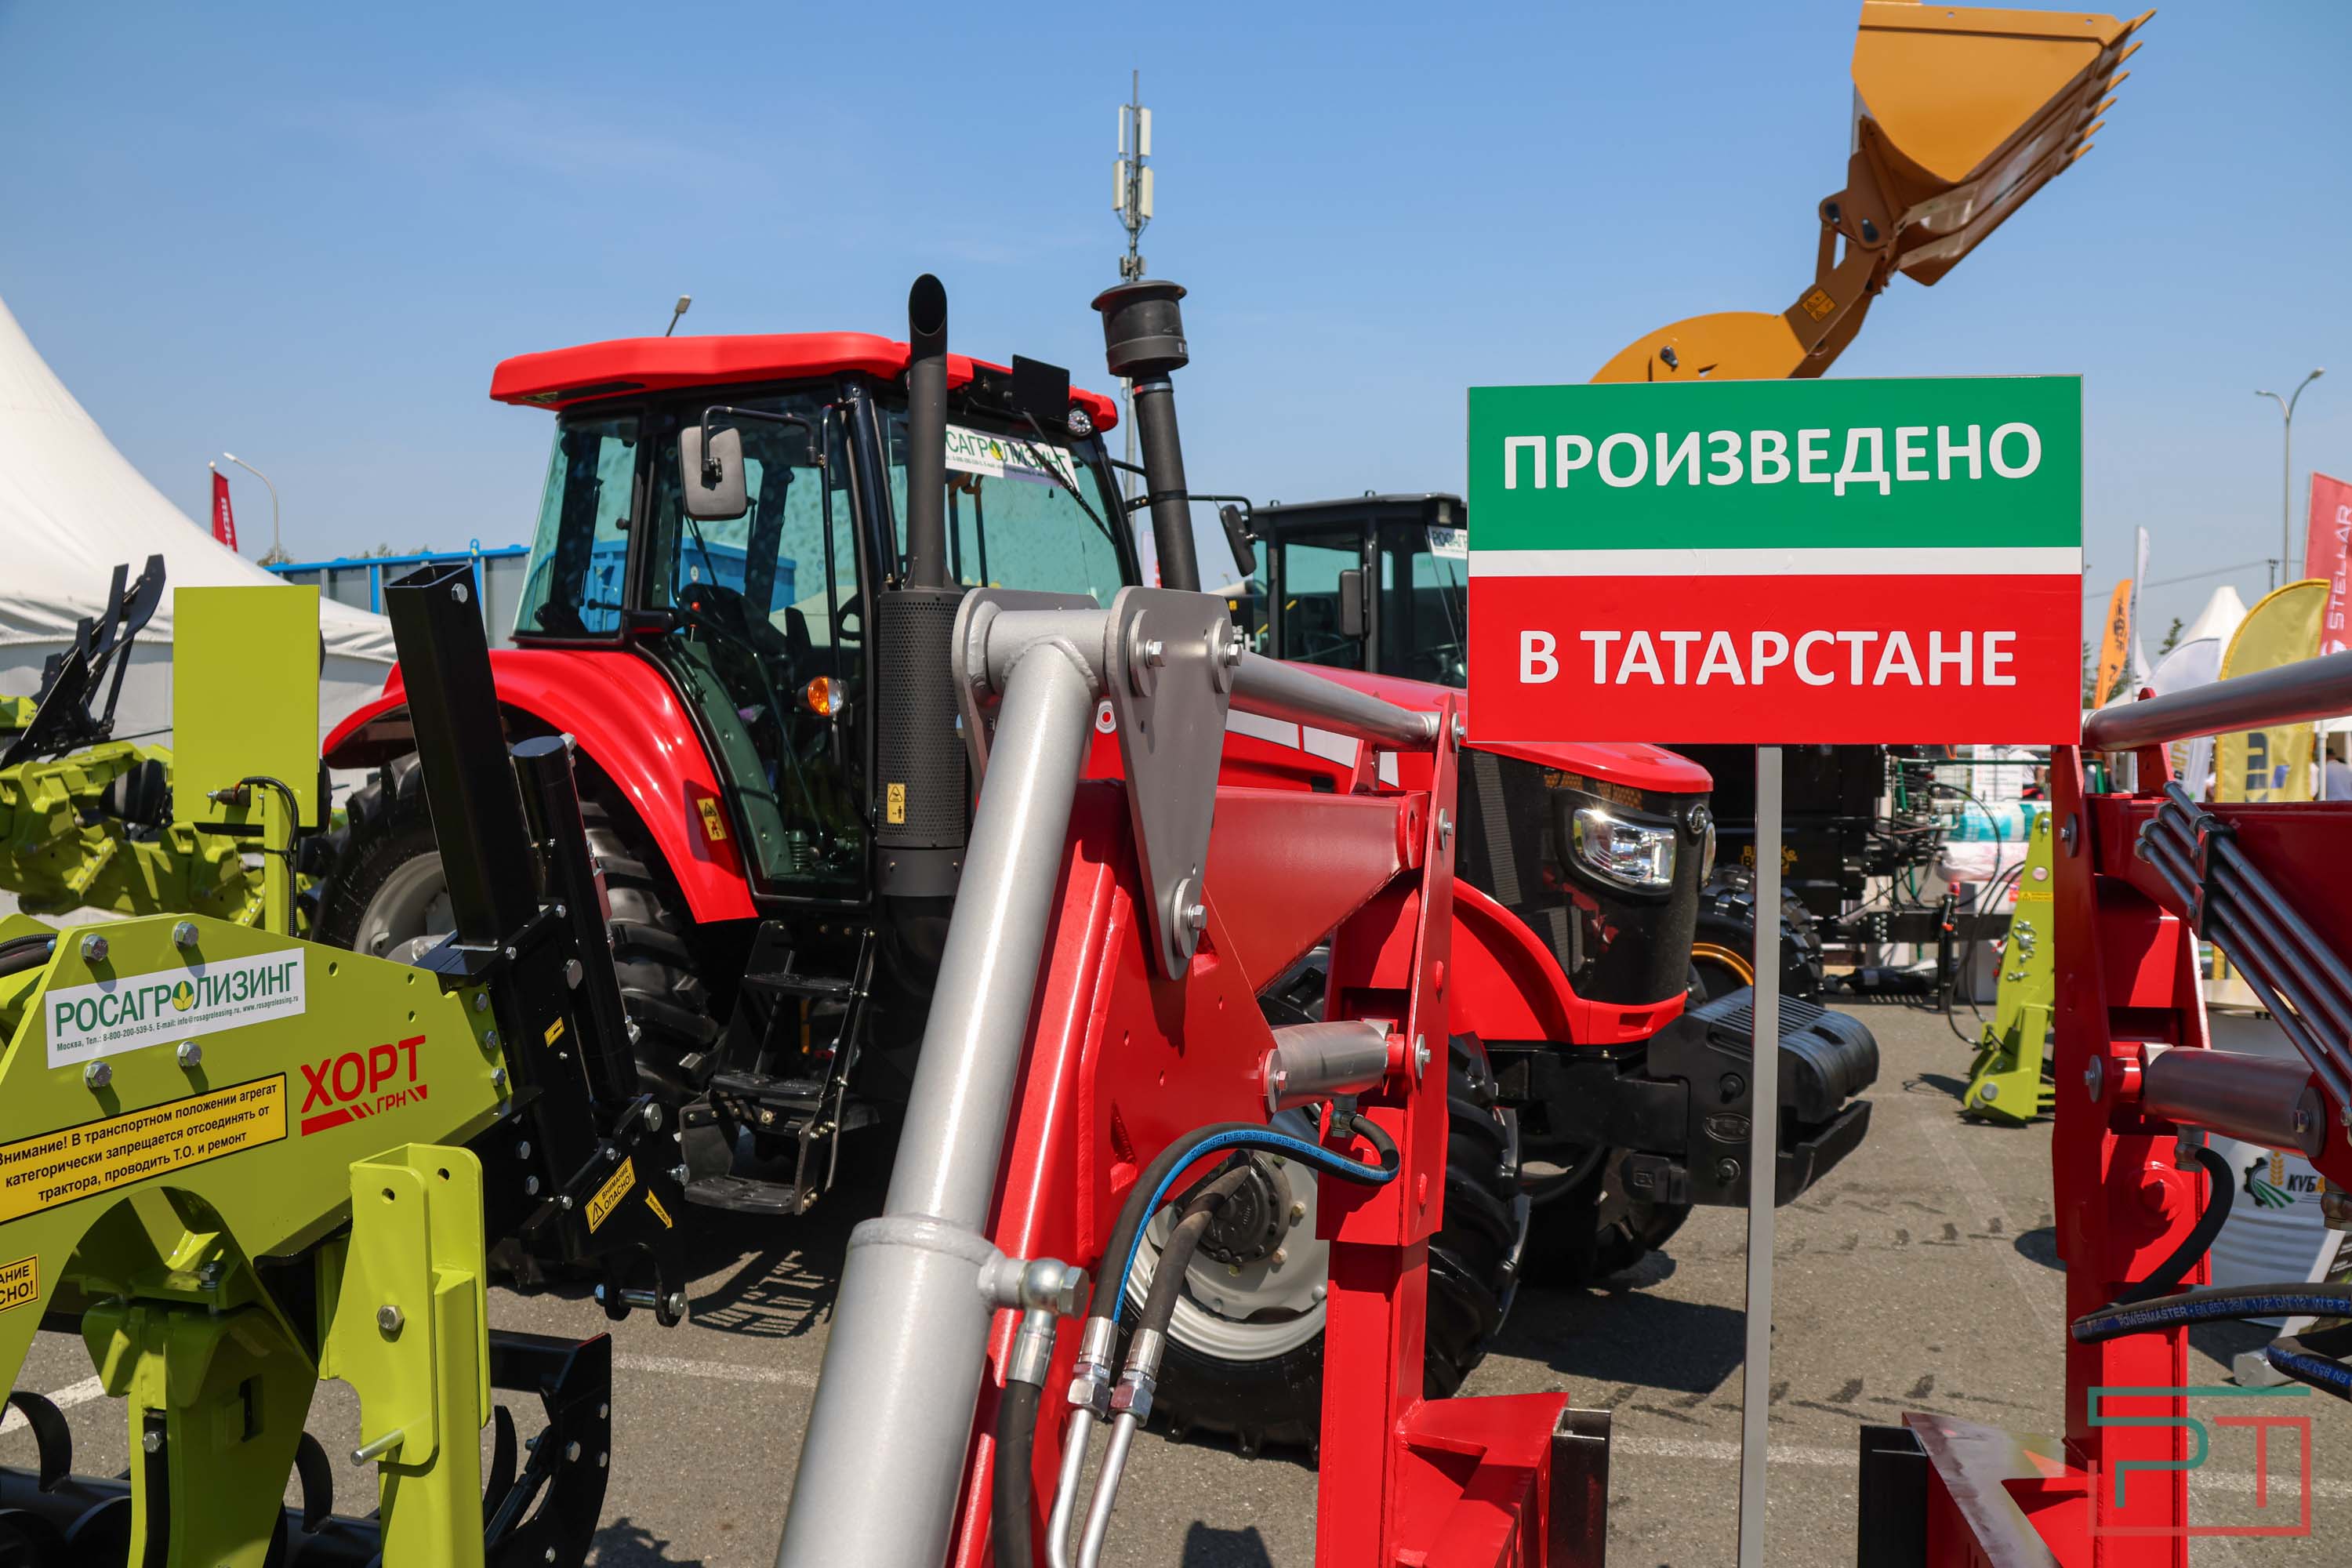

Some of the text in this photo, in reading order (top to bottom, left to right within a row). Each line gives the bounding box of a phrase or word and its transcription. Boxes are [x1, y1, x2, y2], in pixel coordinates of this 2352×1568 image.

[1504, 422, 2042, 497] ПРОИЗВЕДЕНО
[2327, 504, 2352, 630] STELLAR
[1519, 630, 2017, 686] В ТАТАРСТАНЕ
[56, 961, 298, 1037] РОСАГРОЛИЗИНГ
[56, 1039, 85, 1052] Москва,
[85, 1034, 102, 1046] Тел.:
[156, 1018, 176, 1030] E-mail:
[242, 995, 299, 1014] www.rosagroleasing.ru
[300, 1035, 426, 1114] ХОРТ
[376, 1090, 406, 1114] ГРН
[71, 1133, 82, 1147] В
[84, 1112, 172, 1145] транспортном
[175, 1094, 237, 1119] положении
[239, 1083, 277, 1104] агрегат
[5, 1105, 270, 1188] категорически запрещается отсоединять от
[38, 1132, 247, 1203] трактора, проводить Т.О. и ремонт
[601, 1165, 629, 1200] ВНИМАНИЕ
[604, 1172, 633, 1210] ОПАСНО!
[2287, 1174, 2326, 1192] КУБА
[2118, 1305, 2188, 1327] POWERMASTER
